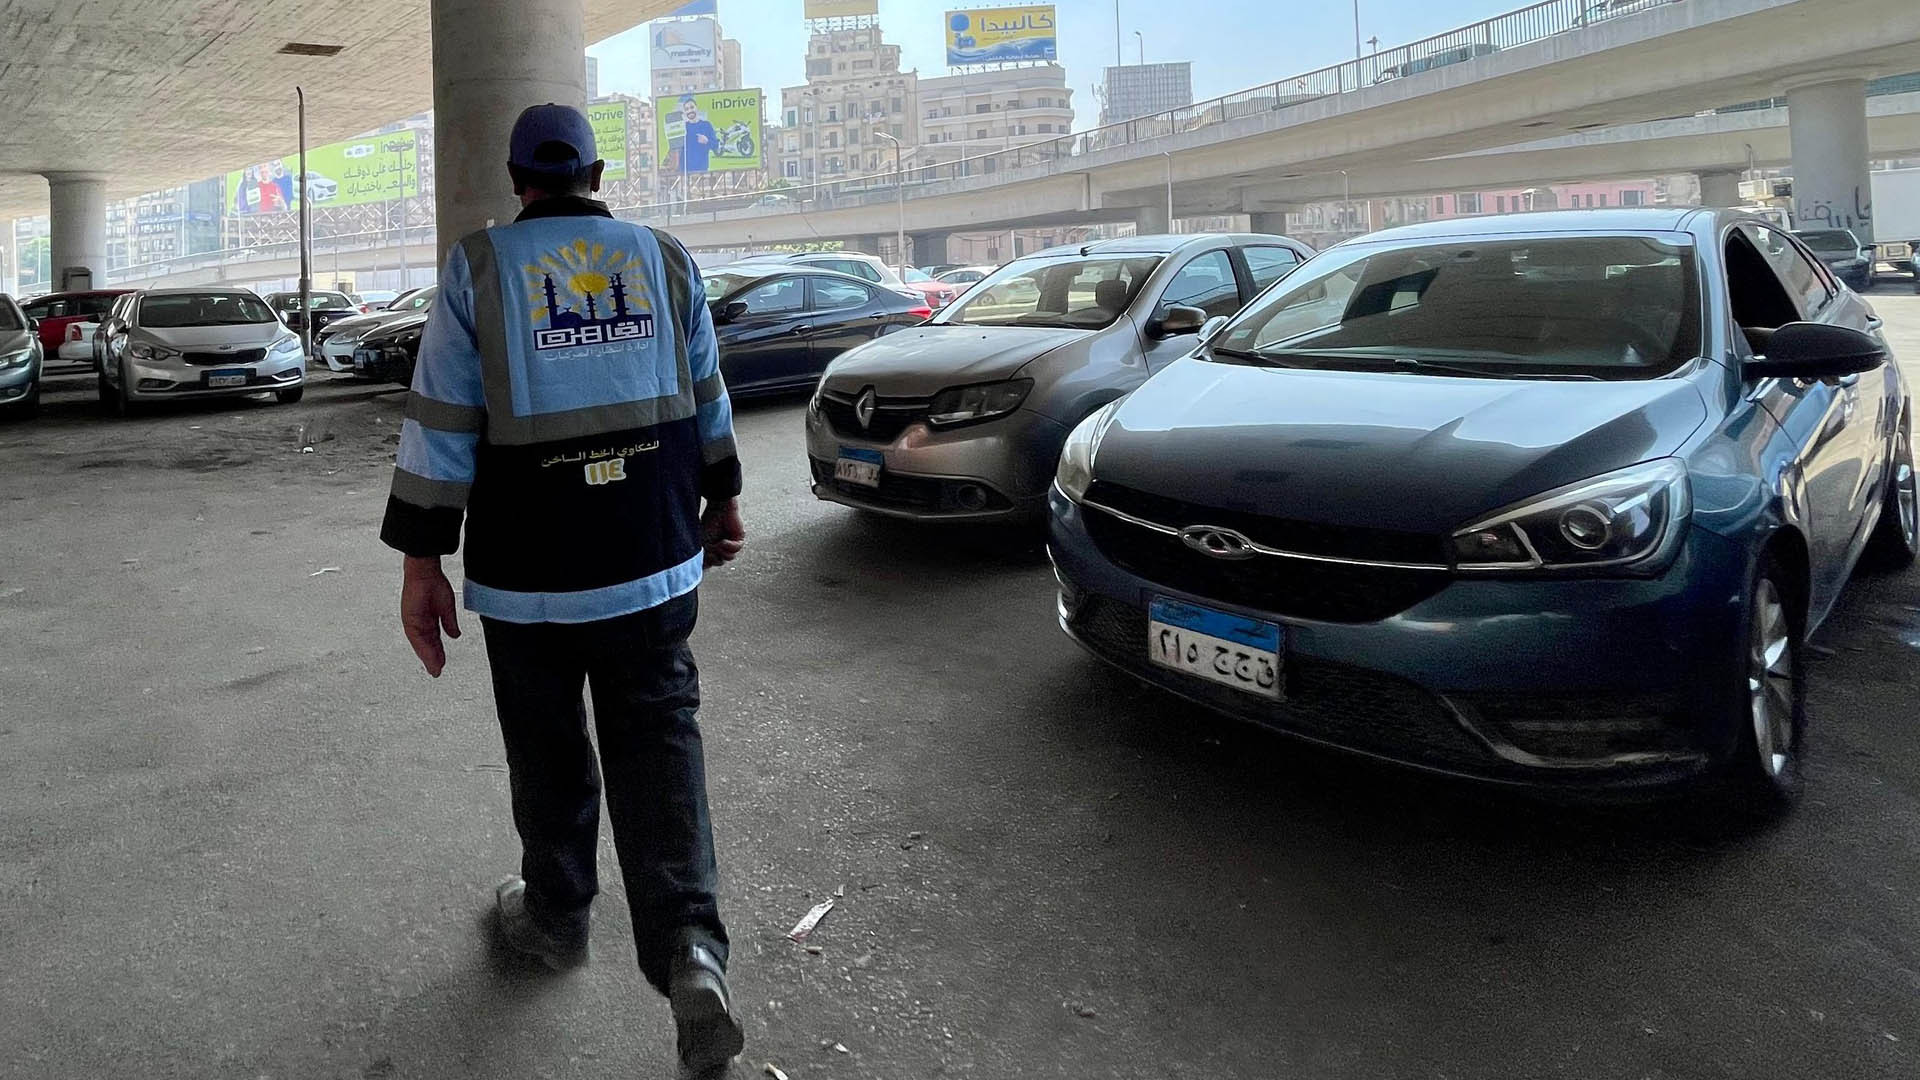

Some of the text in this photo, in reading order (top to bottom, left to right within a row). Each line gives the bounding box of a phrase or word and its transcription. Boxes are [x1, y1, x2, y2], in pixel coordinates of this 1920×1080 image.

[711, 96, 756, 109] inDrive
[588, 110, 624, 121] nDrive
[541, 450, 586, 467] الساخن
[589, 447, 614, 459] الخط
